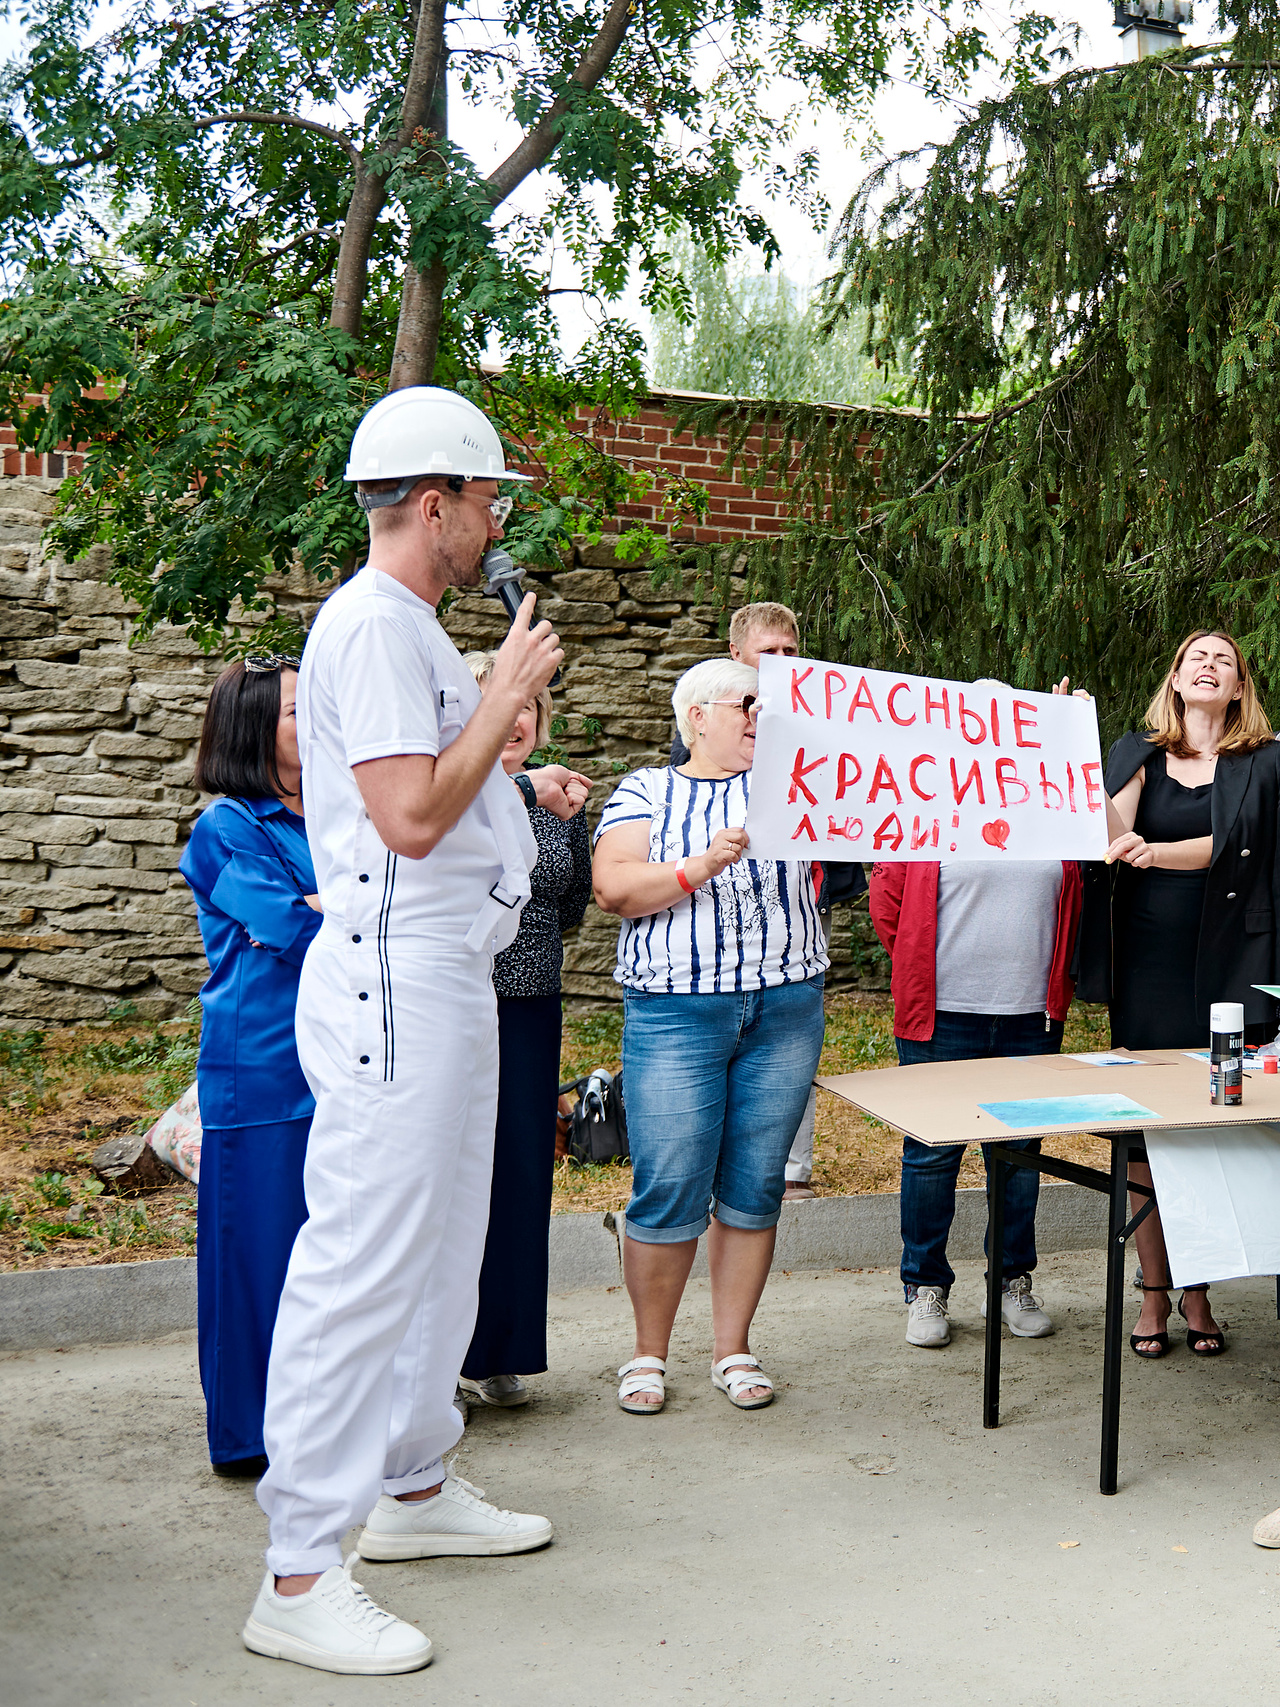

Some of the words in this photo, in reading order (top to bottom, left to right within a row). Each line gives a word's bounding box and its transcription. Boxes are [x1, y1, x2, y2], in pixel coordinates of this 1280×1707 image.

[790, 666, 1042, 750] КРАСНЫЕ
[787, 747, 1102, 814] КРАСИВЫЕ
[790, 810, 960, 852] ЛЮДИ!
